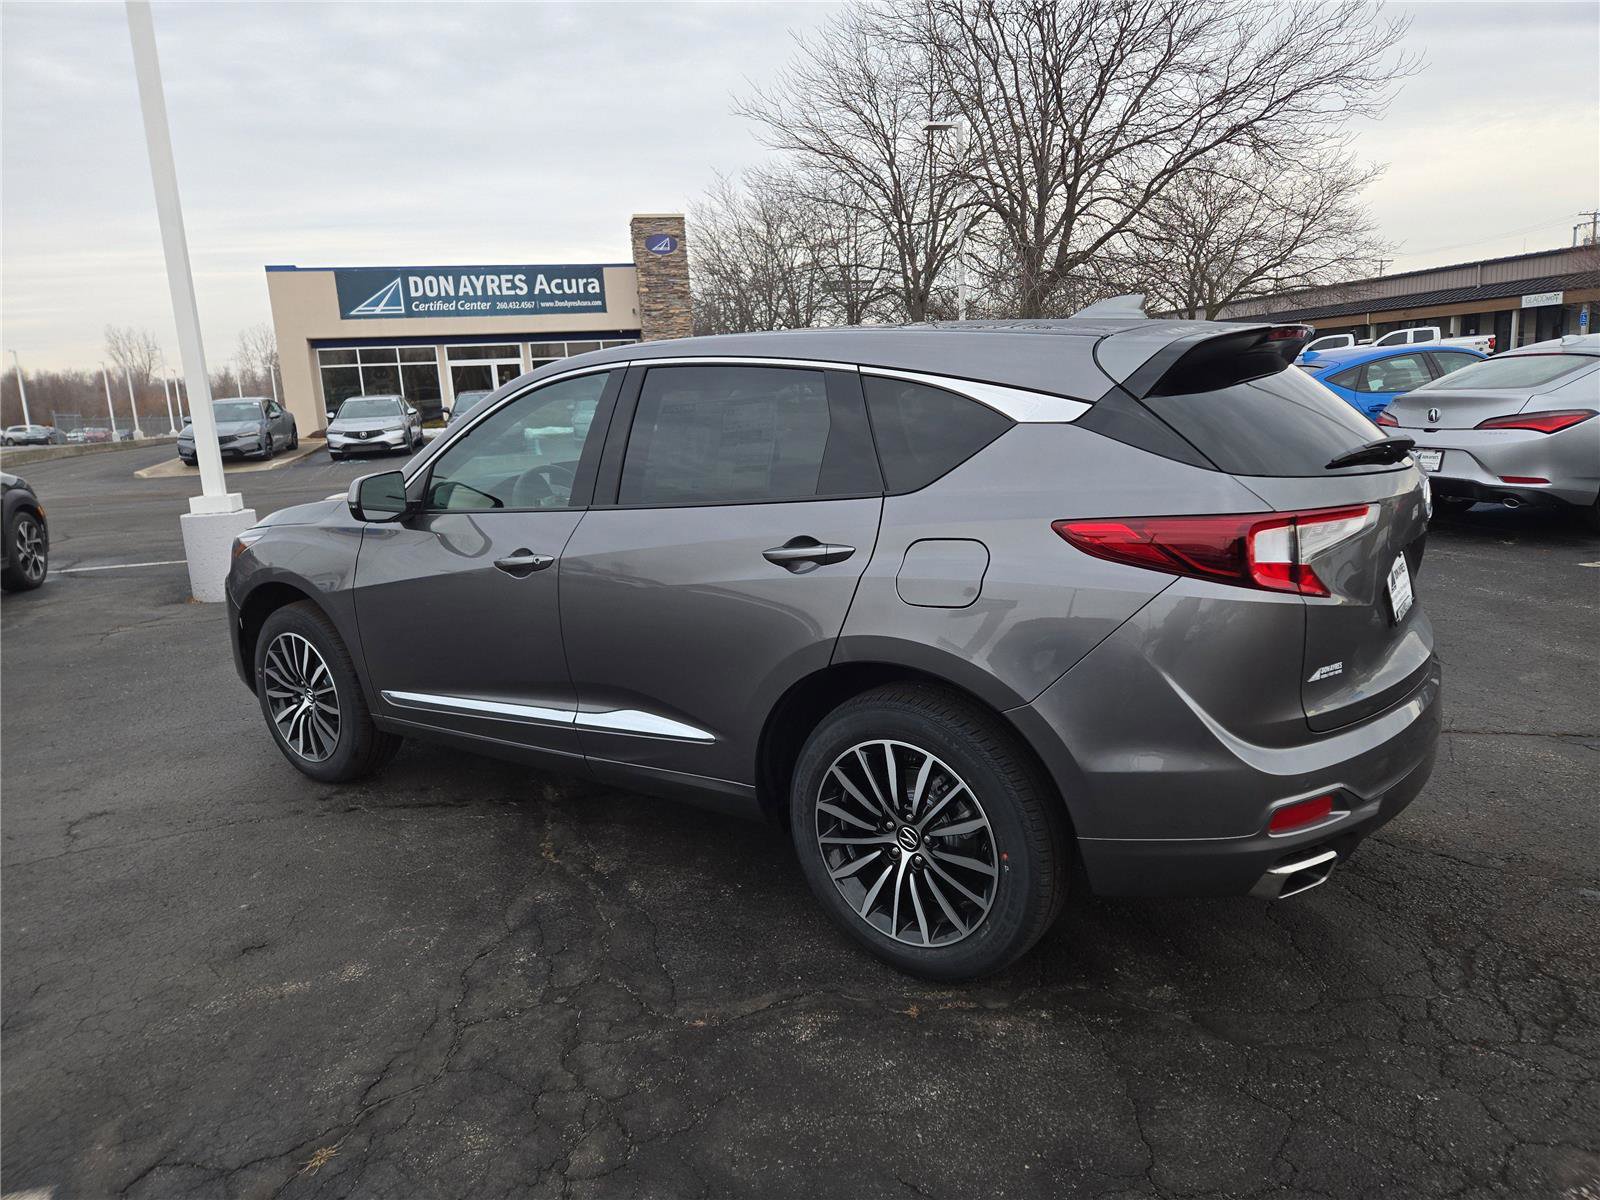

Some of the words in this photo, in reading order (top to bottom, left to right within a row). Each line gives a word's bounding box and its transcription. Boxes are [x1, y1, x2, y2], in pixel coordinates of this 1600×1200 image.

[408, 275, 455, 297] DON
[458, 273, 528, 296] AYRES
[534, 273, 600, 295] Acura
[411, 300, 456, 312] Certified
[457, 300, 491, 311] Center
[496, 301, 535, 310] 260.432.4567
